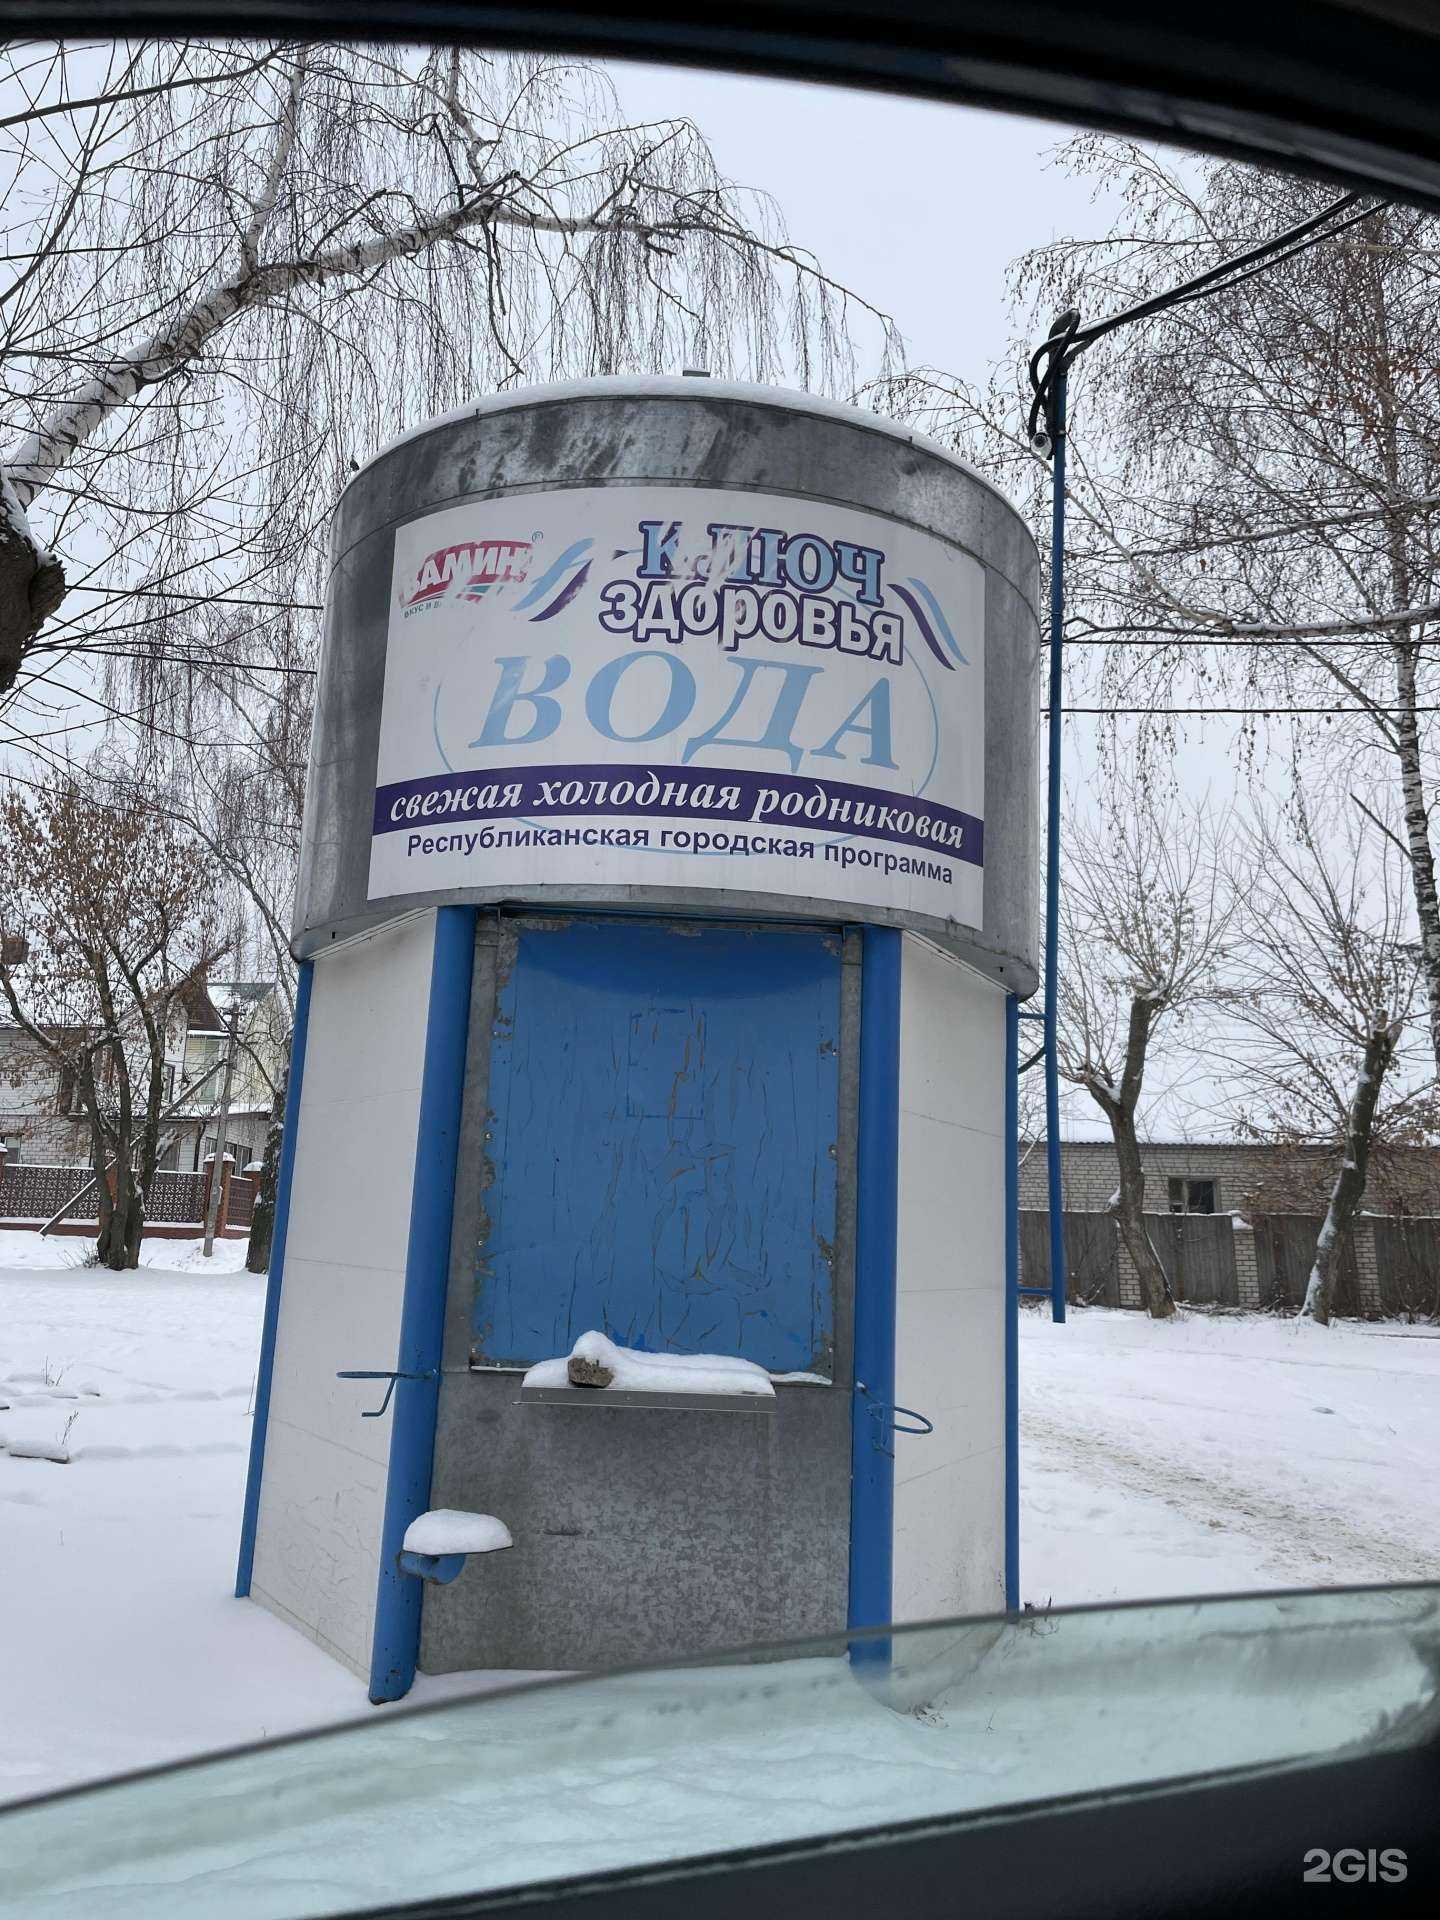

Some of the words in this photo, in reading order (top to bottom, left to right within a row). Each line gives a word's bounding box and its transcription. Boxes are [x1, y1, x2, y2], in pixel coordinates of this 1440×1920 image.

[637, 521, 885, 608] КЛЮЧ
[468, 650, 900, 774] ВОДА
[390, 783, 523, 821] свежая
[533, 770, 742, 811] холодная
[748, 785, 964, 849] родниковая
[407, 826, 649, 856] Республиканская
[660, 829, 815, 858] городская
[824, 844, 954, 885] программа
